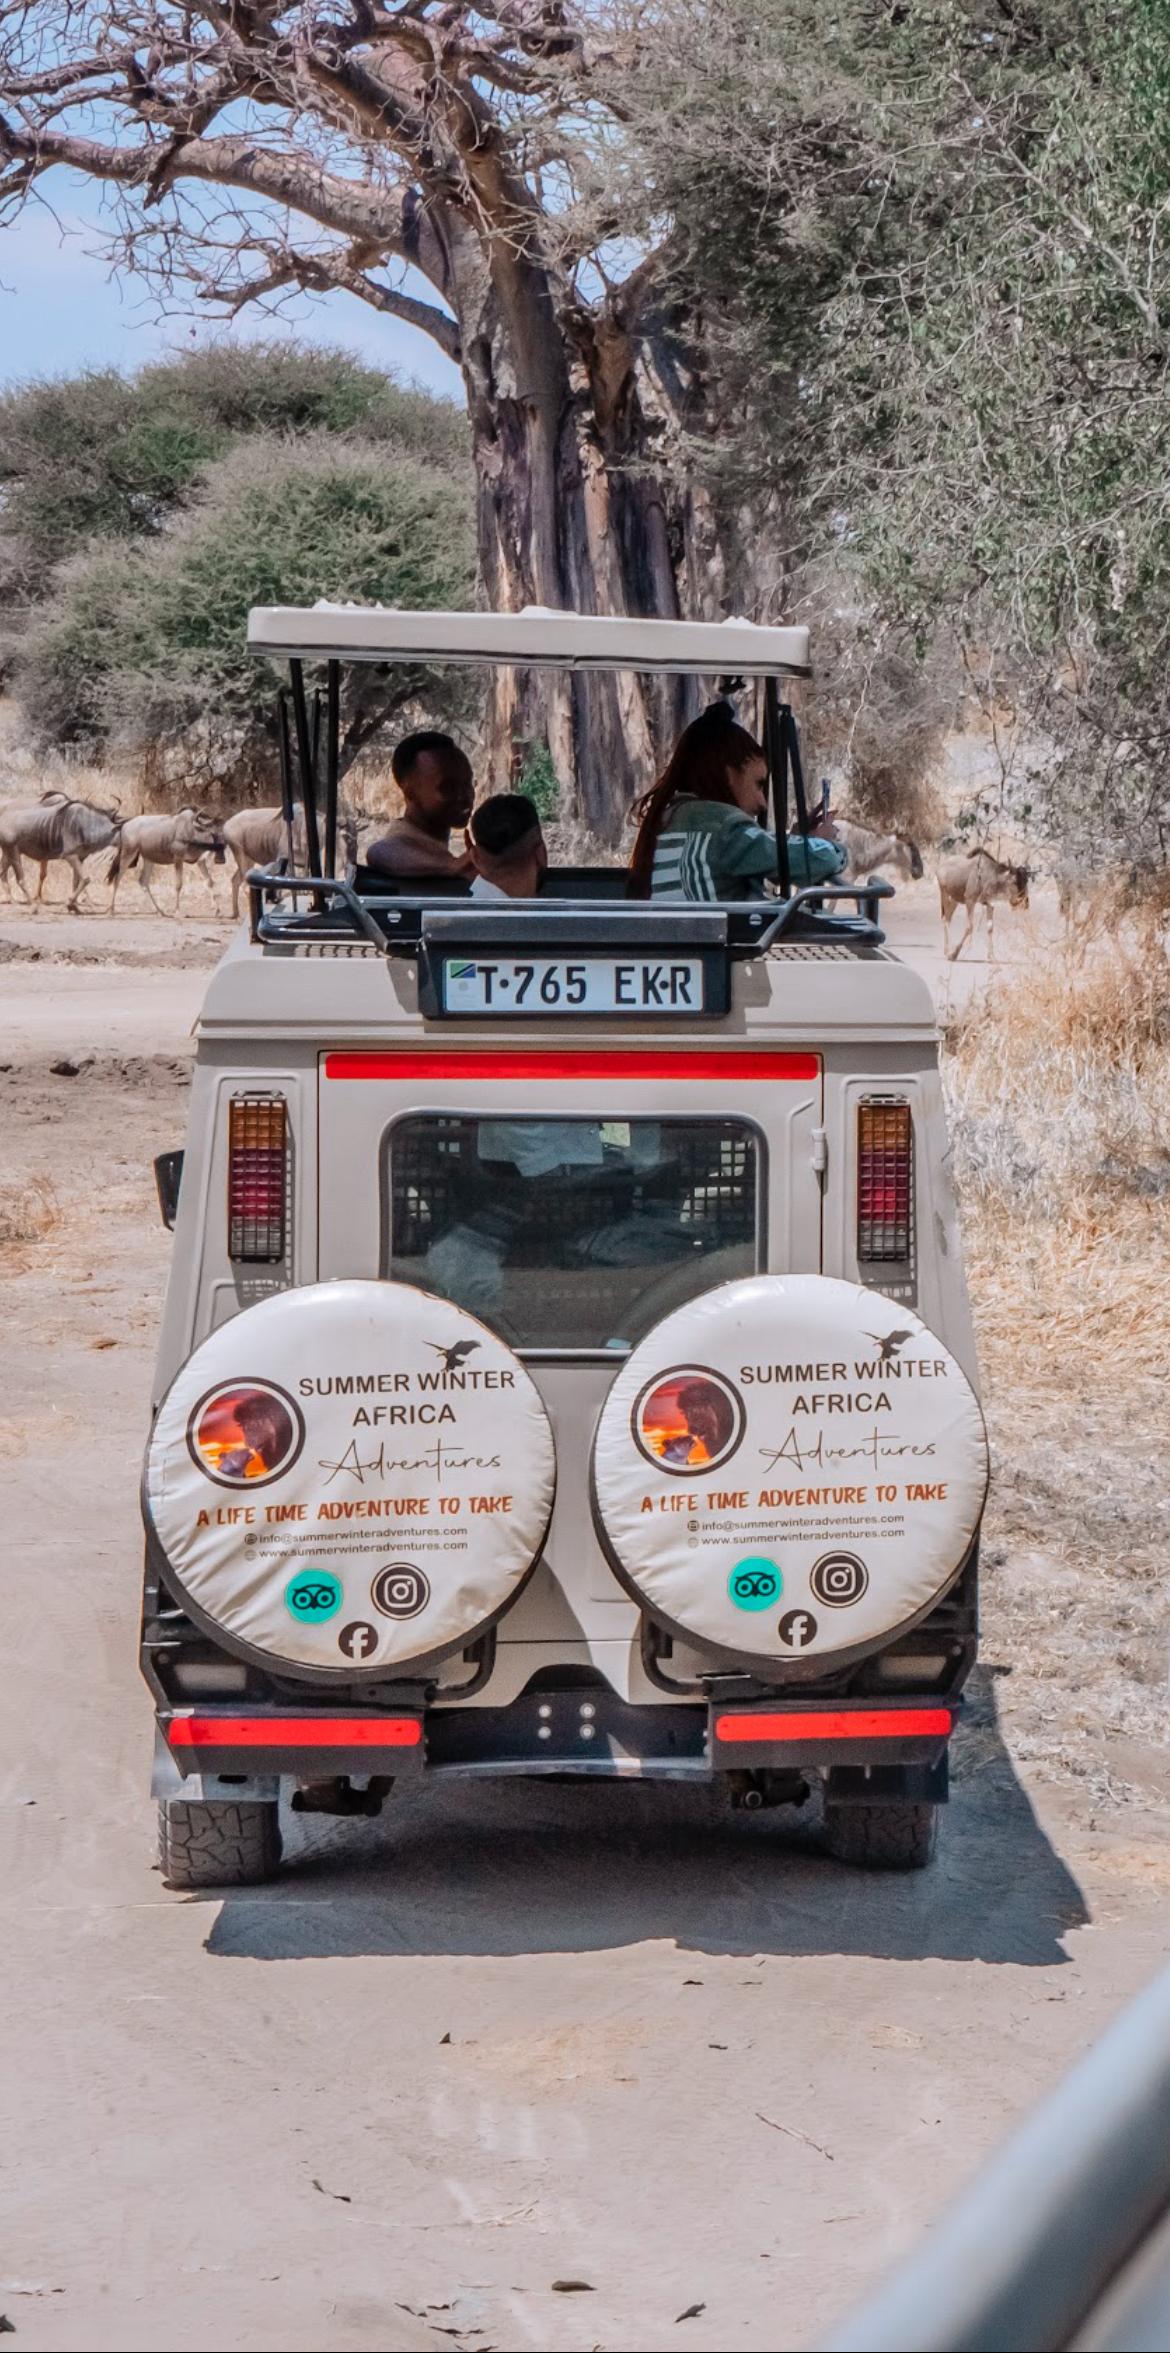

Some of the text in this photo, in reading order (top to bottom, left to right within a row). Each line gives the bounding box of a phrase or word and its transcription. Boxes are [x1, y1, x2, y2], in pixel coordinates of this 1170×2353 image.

[514, 966, 587, 1005] 765
[299, 1369, 515, 1396] SUMMER WINTER
[740, 1360, 948, 1384] SUMMER WINTER
[353, 1404, 456, 1426] AFRICA
[792, 1393, 892, 1415] AFRICA
[318, 1438, 501, 1486] Adventures
[758, 1426, 936, 1474] Adventures
[640, 1483, 949, 1513] A LIFE TIME ADVENTURE TO TAKE
[196, 1496, 513, 1527] A LIFE TIME ADVENTURE TO TAKE
[701, 1514, 905, 1531] info@summerwinteradventures.com
[259, 1525, 468, 1545] info@summerwinteradventures.com
[701, 1528, 905, 1546] www.summerwinteradventures.com
[259, 1541, 469, 1558] www.summerwinteradventures.com
